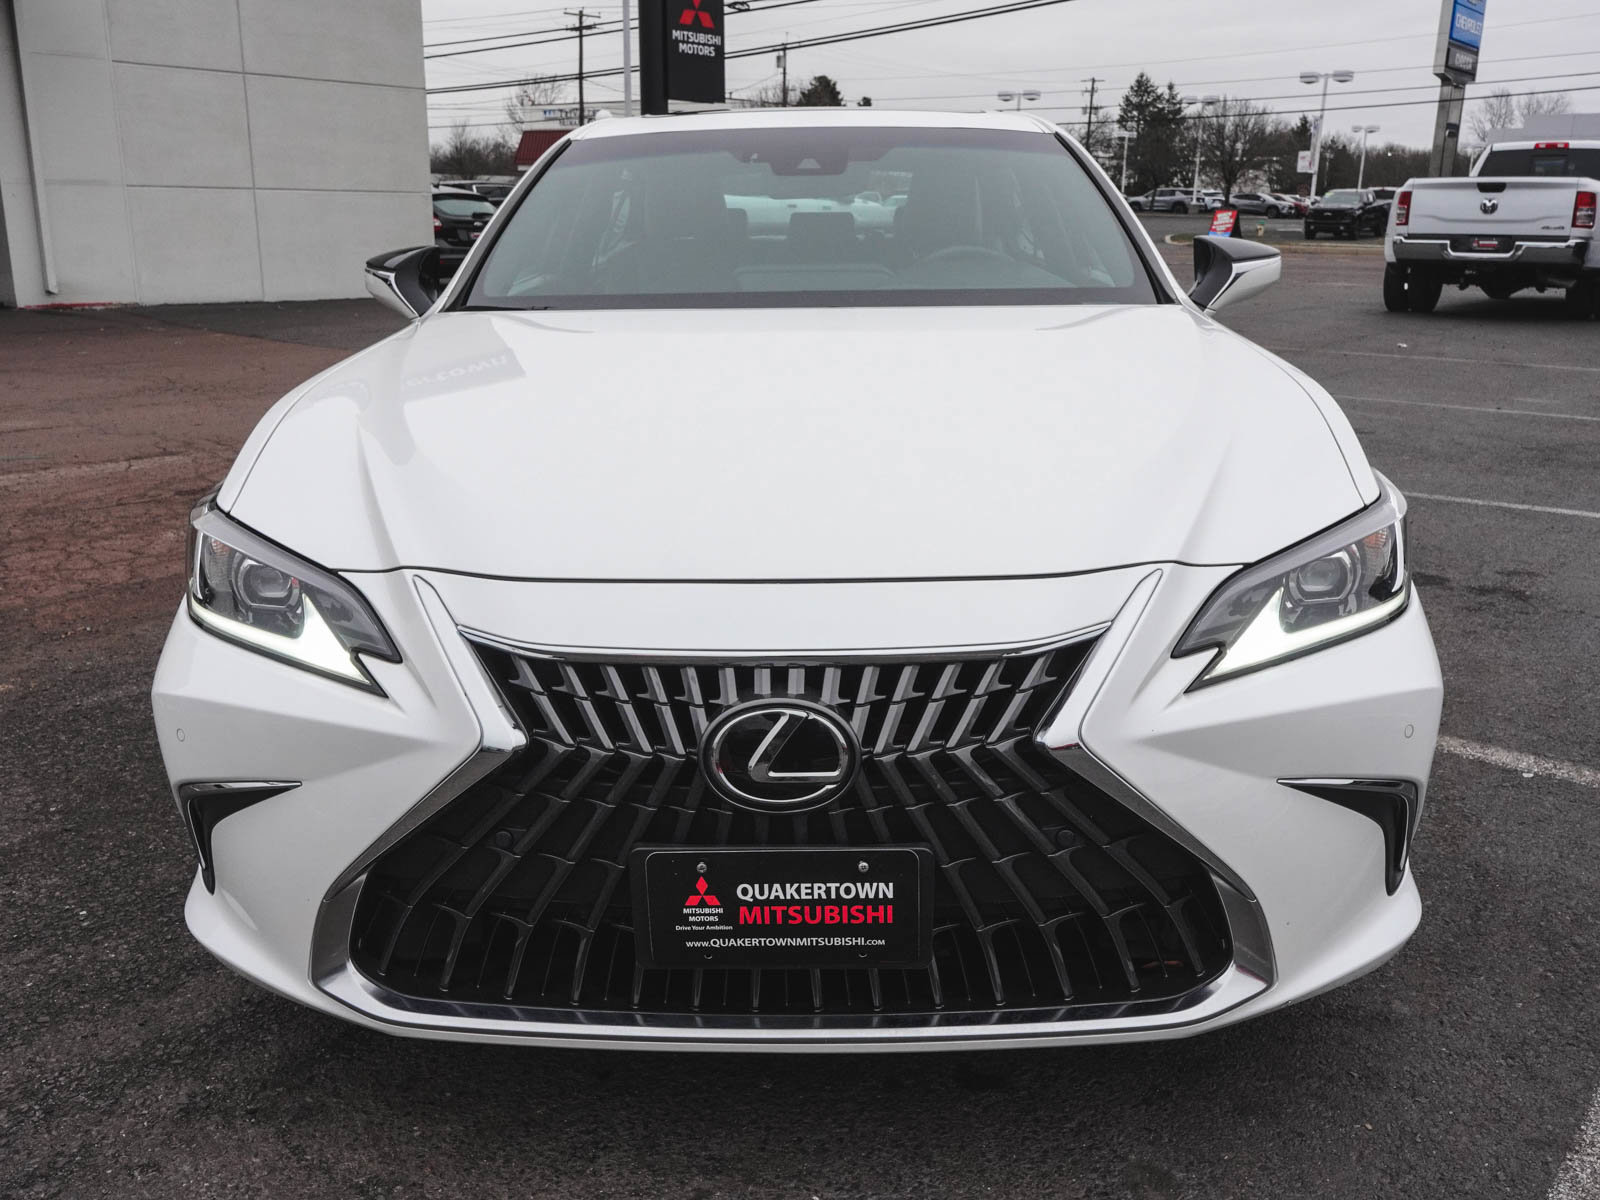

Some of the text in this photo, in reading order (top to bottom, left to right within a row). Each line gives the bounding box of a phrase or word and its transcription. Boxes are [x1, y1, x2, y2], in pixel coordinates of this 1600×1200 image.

[672, 29, 722, 46] MITSUBISHI
[678, 42, 716, 57] MOTORS
[736, 882, 894, 902] QUAKERTOWN
[738, 904, 894, 925] MITSUBISHI
